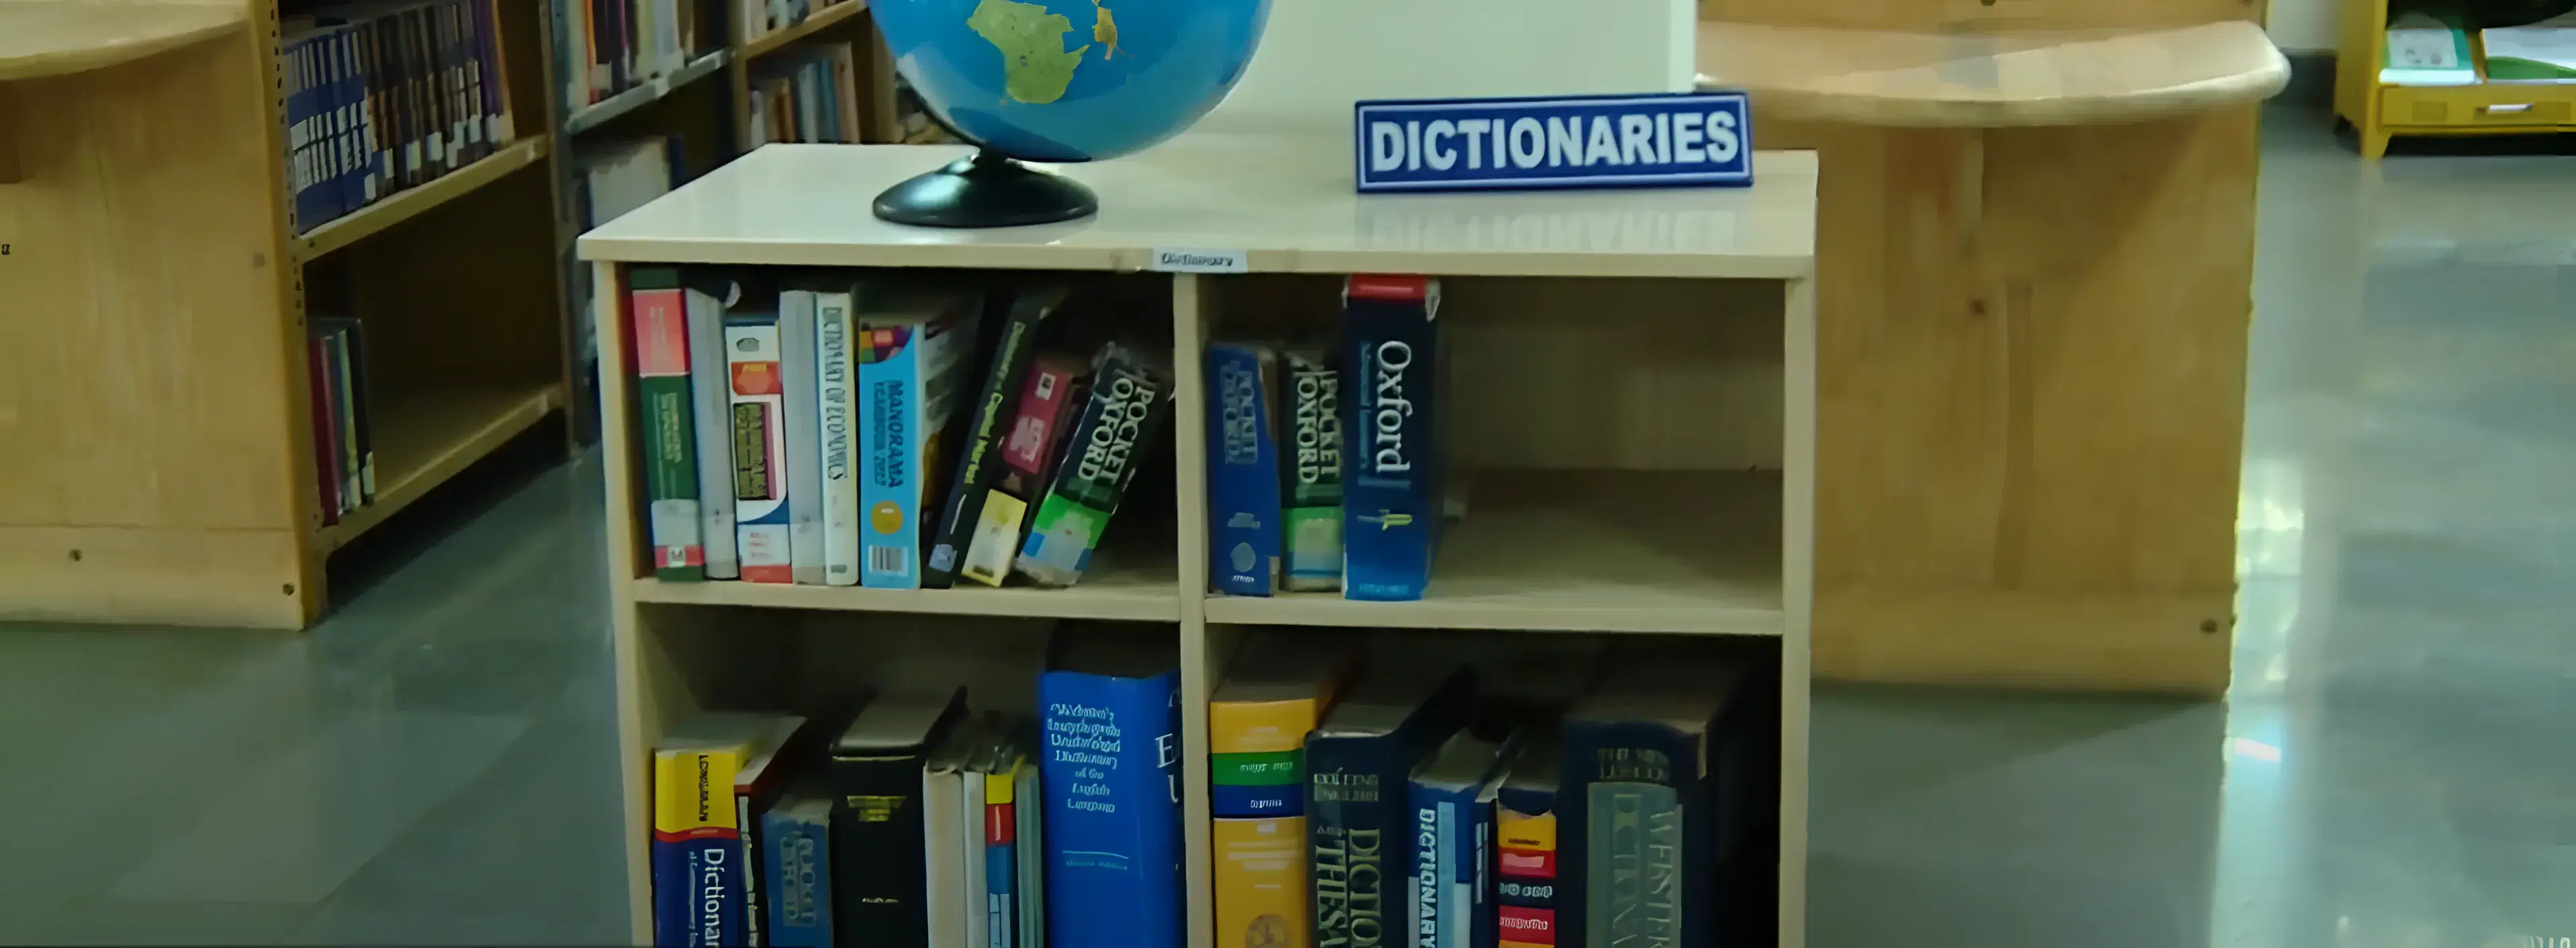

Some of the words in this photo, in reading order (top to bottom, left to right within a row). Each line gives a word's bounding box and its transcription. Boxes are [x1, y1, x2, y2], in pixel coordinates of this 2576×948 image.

[1371, 112, 1740, 172] DICTIONARIES
[887, 379, 905, 488] MANORAMA
[1077, 378, 1133, 481] OXFORD
[1099, 384, 1156, 486] POCKET
[1297, 376, 1319, 484] OXFORD
[1318, 377, 1342, 477] POCKET
[1377, 340, 1413, 473] Oxford
[1348, 828, 1383, 948] DICTIO
